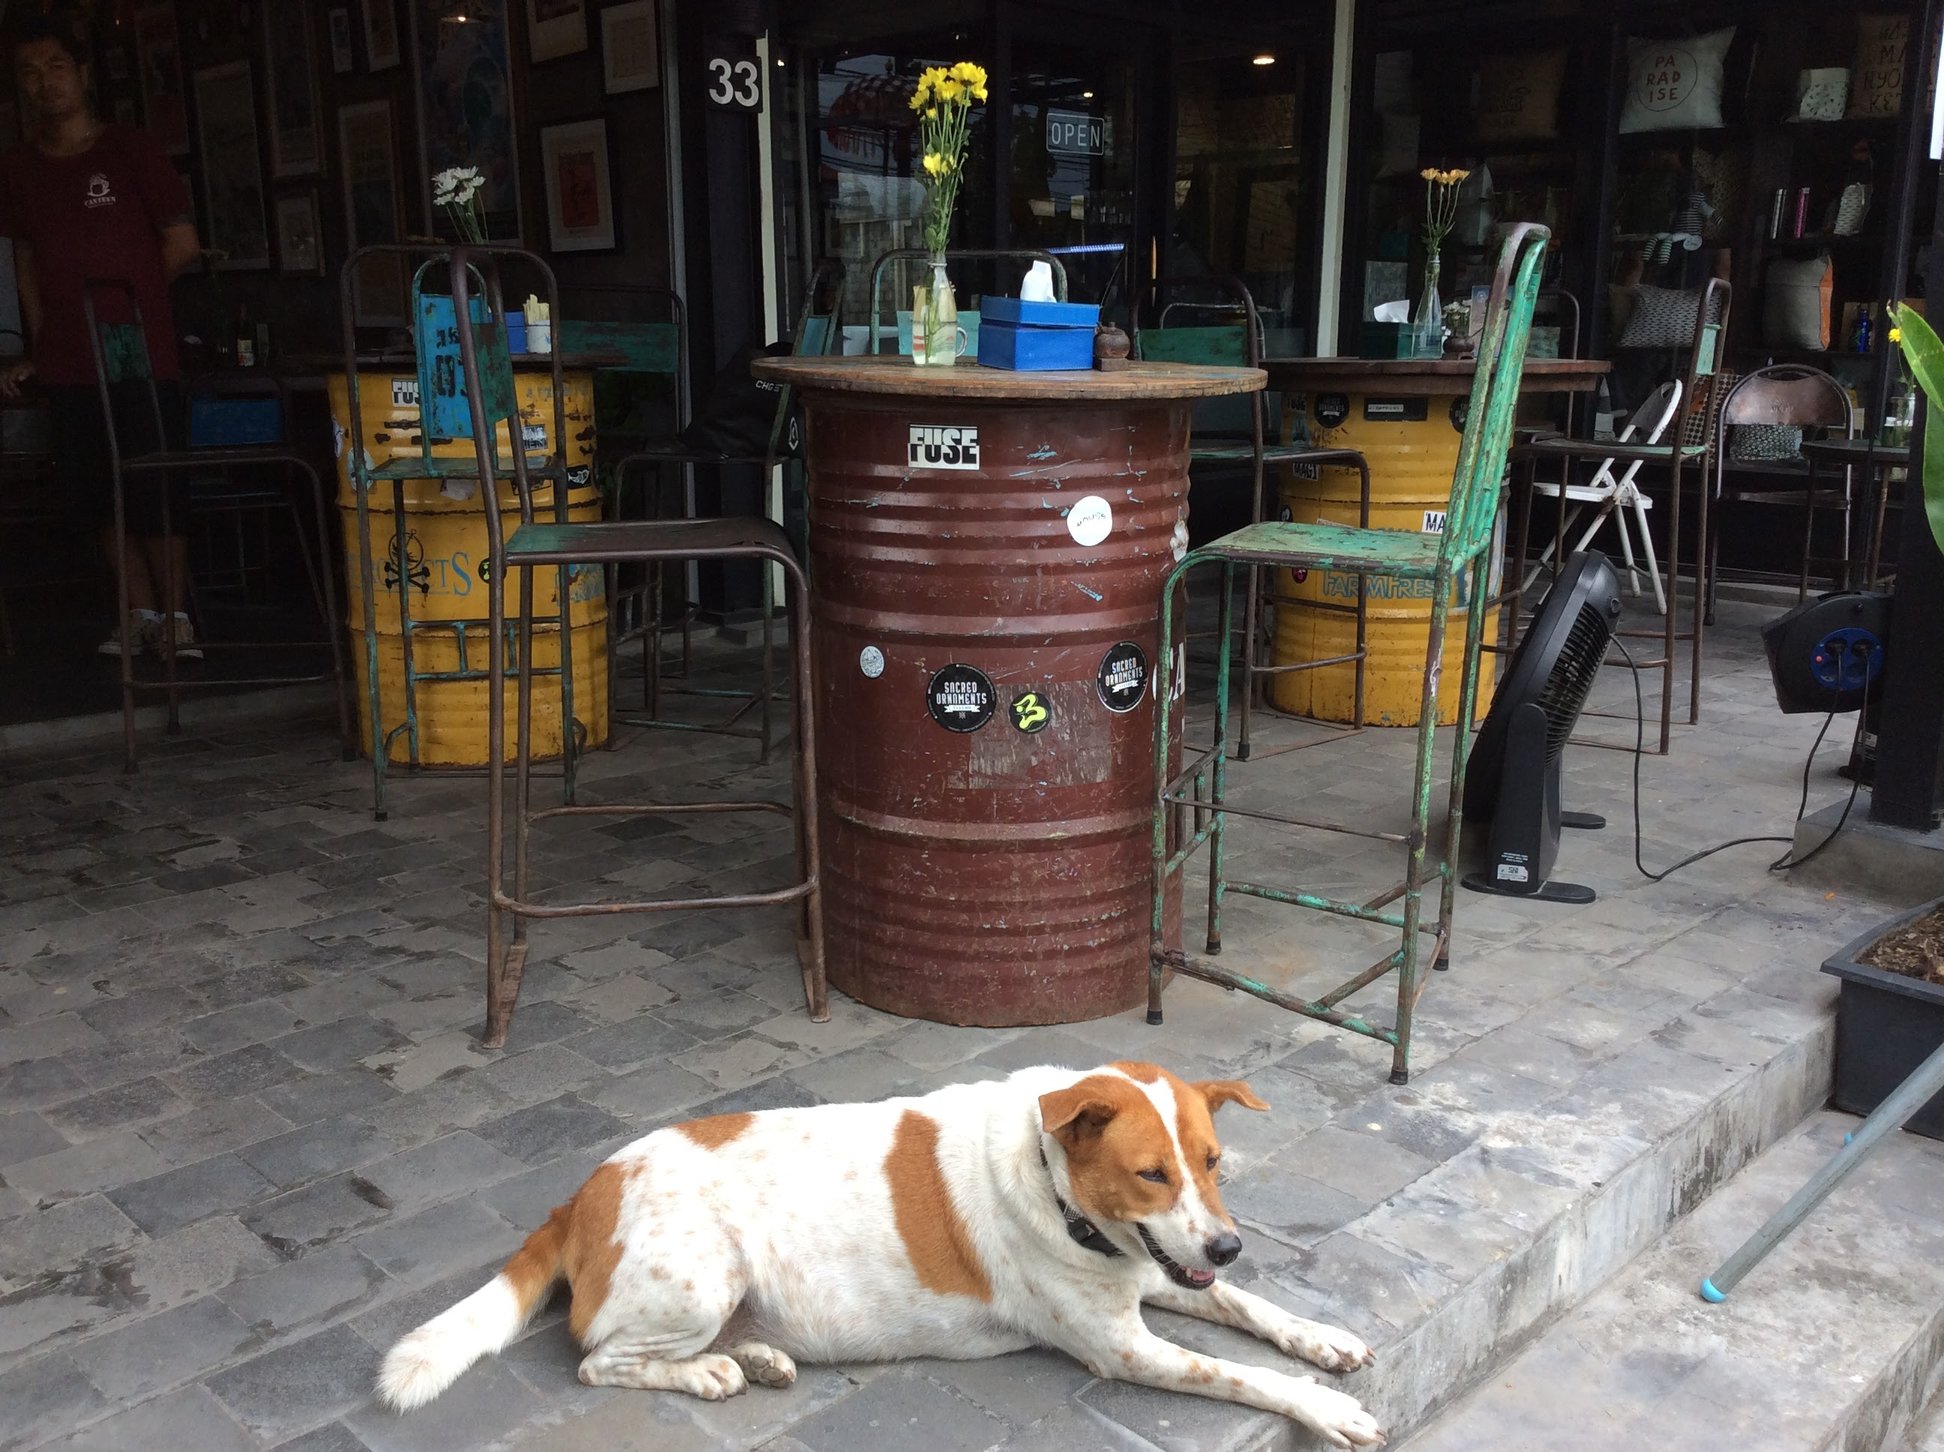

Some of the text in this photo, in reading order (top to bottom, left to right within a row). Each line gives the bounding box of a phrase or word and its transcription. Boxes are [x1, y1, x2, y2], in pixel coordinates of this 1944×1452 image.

[1655, 55, 1675, 67] PA
[709, 58, 760, 107] 33
[1647, 71, 1680, 86] RAD
[1649, 87, 1678, 103] ISE
[1051, 122, 1100, 148] OPEN
[909, 427, 979, 464] FUSE
[1111, 656, 1137, 674] SACRED
[1104, 665, 1144, 687] ORNAMENTS
[944, 681, 978, 694] SACRED
[935, 692, 988, 705] ORNAMENTS
